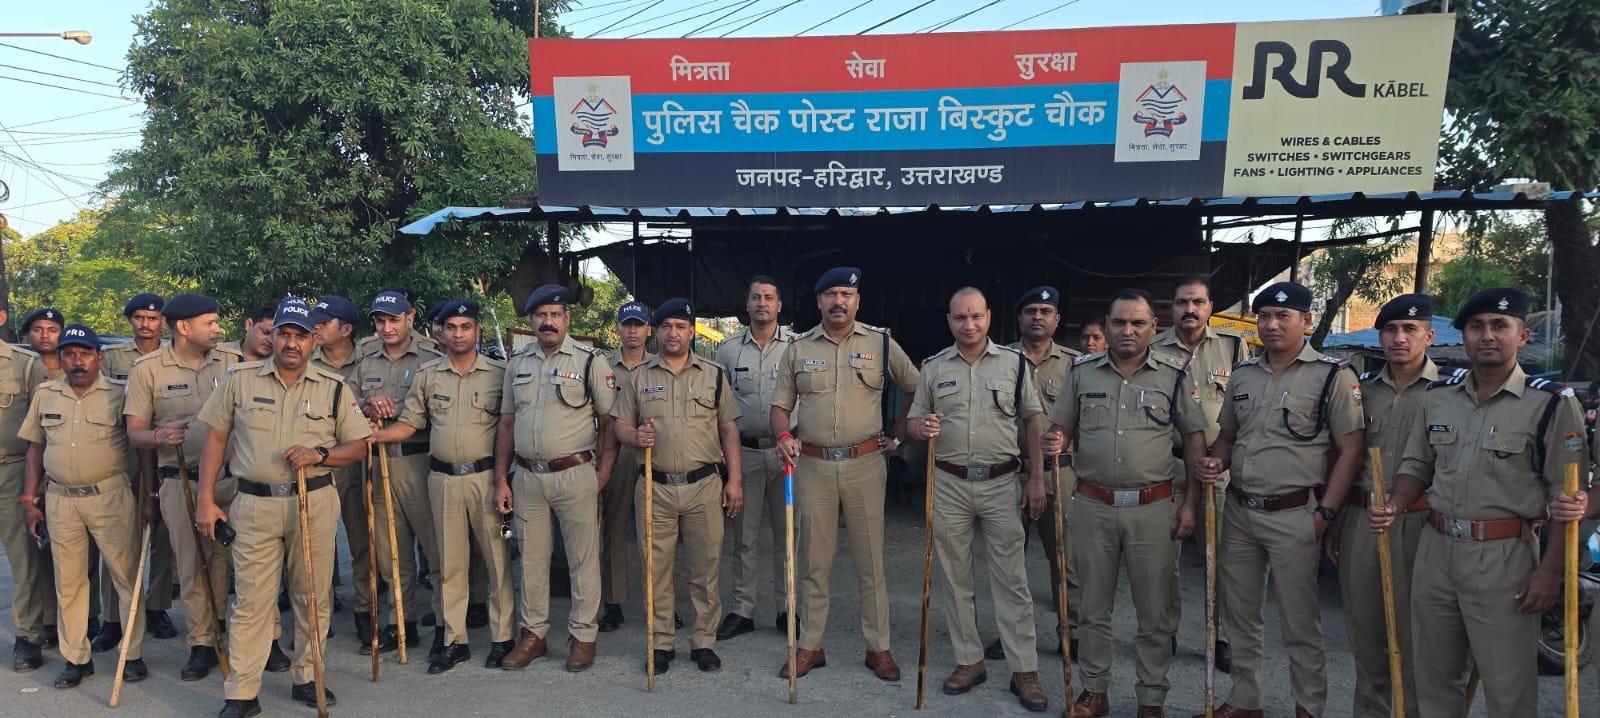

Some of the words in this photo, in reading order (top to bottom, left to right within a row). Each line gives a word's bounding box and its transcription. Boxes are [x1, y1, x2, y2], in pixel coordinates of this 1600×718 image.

[670, 55, 731, 81] मित्रता
[845, 51, 885, 79] सेवा
[1014, 51, 1078, 80] सुरक्षा
[1242, 39, 1367, 100] RR
[642, 100, 723, 145] पुलिस
[730, 99, 781, 134] चैक
[788, 99, 856, 134] पोस्ट
[864, 106, 928, 132] राजा
[937, 95, 1035, 142] बिस्कुट
[1044, 90, 1107, 127] चौक
[1280, 137, 1319, 147] WIRES
[1322, 137, 1330, 146] &
[1333, 136, 1381, 146] CABLES
[1247, 152, 1310, 162] SWITCHES
[1321, 151, 1411, 161] SWITCHGEARS
[900, 164, 1004, 185] उत्तराखण्ड
[1233, 167, 1266, 177] FANS
[1277, 167, 1335, 177] LIGHTING
[1346, 166, 1422, 176] APPLIANCES
[375, 296, 397, 304] POLICE
[283, 306, 309, 317] POLICE
[623, 303, 641, 313] POLICE
[65, 328, 86, 337] PRD
